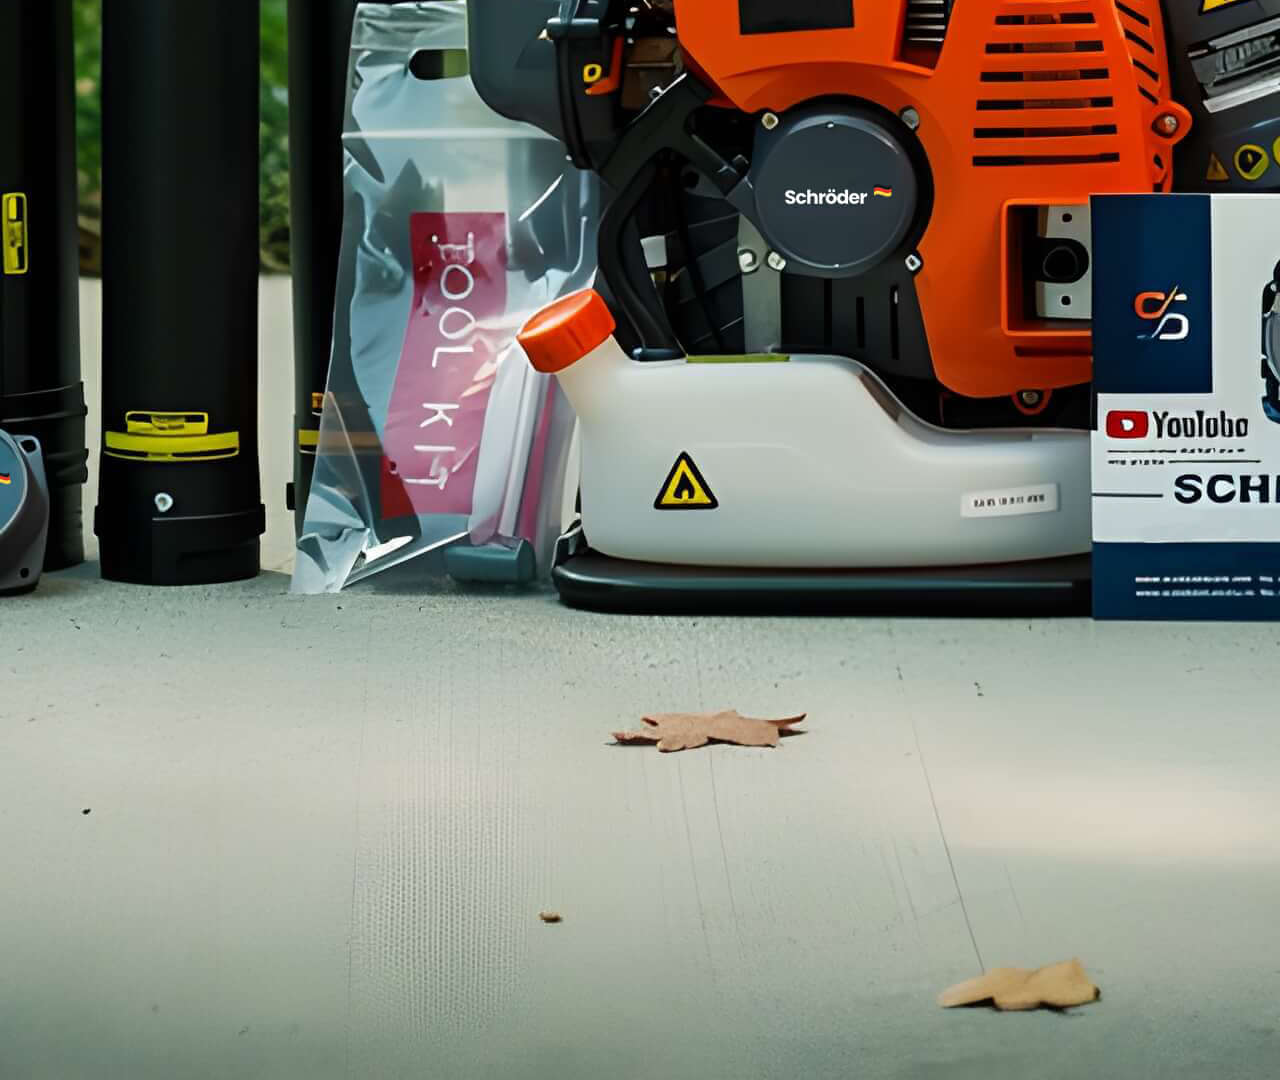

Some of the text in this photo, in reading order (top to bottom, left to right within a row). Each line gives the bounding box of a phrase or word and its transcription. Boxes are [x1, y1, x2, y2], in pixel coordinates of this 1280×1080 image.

[784, 188, 868, 205] Schröder
[403, 232, 476, 490] TOOL KIT
